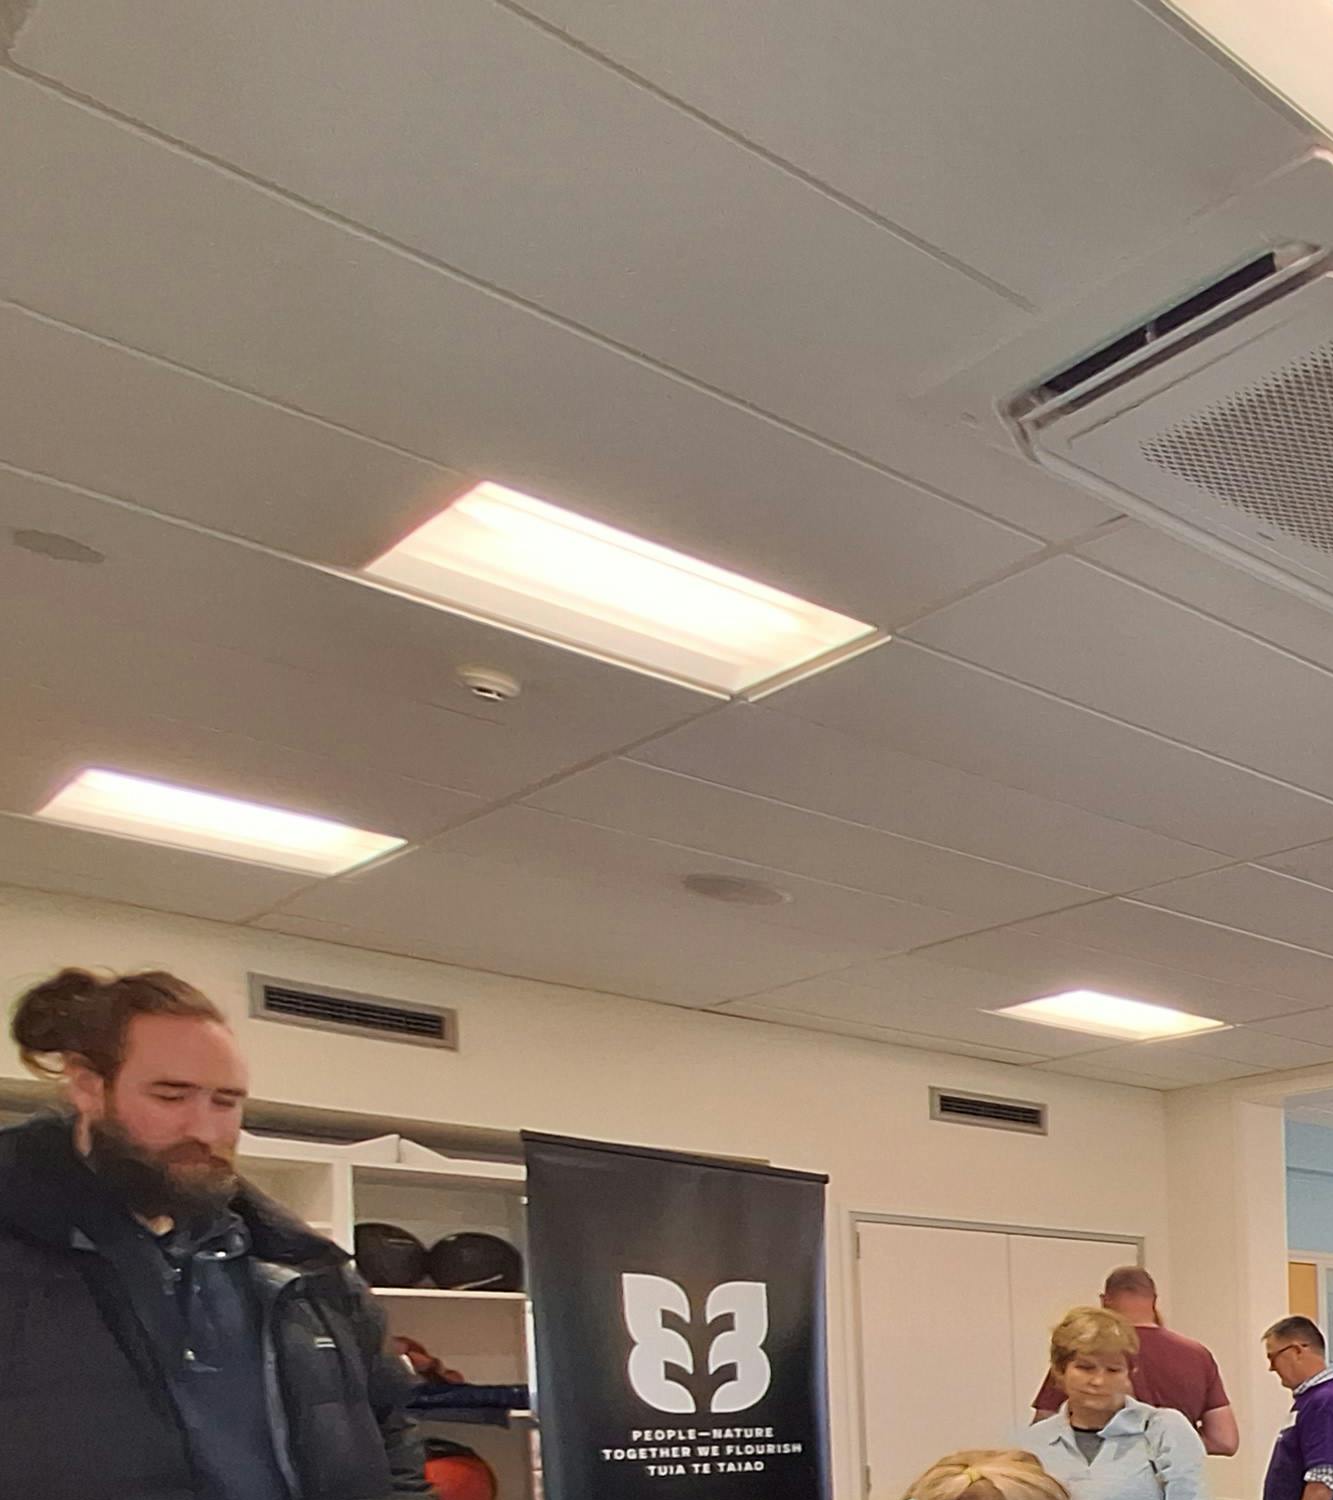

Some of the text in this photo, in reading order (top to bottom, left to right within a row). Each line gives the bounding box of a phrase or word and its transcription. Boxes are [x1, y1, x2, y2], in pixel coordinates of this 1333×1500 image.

[601, 1443, 802, 1460] TOGETHER WE FLOURISH
[647, 1462, 764, 1477] TUIA TE TAIAO
